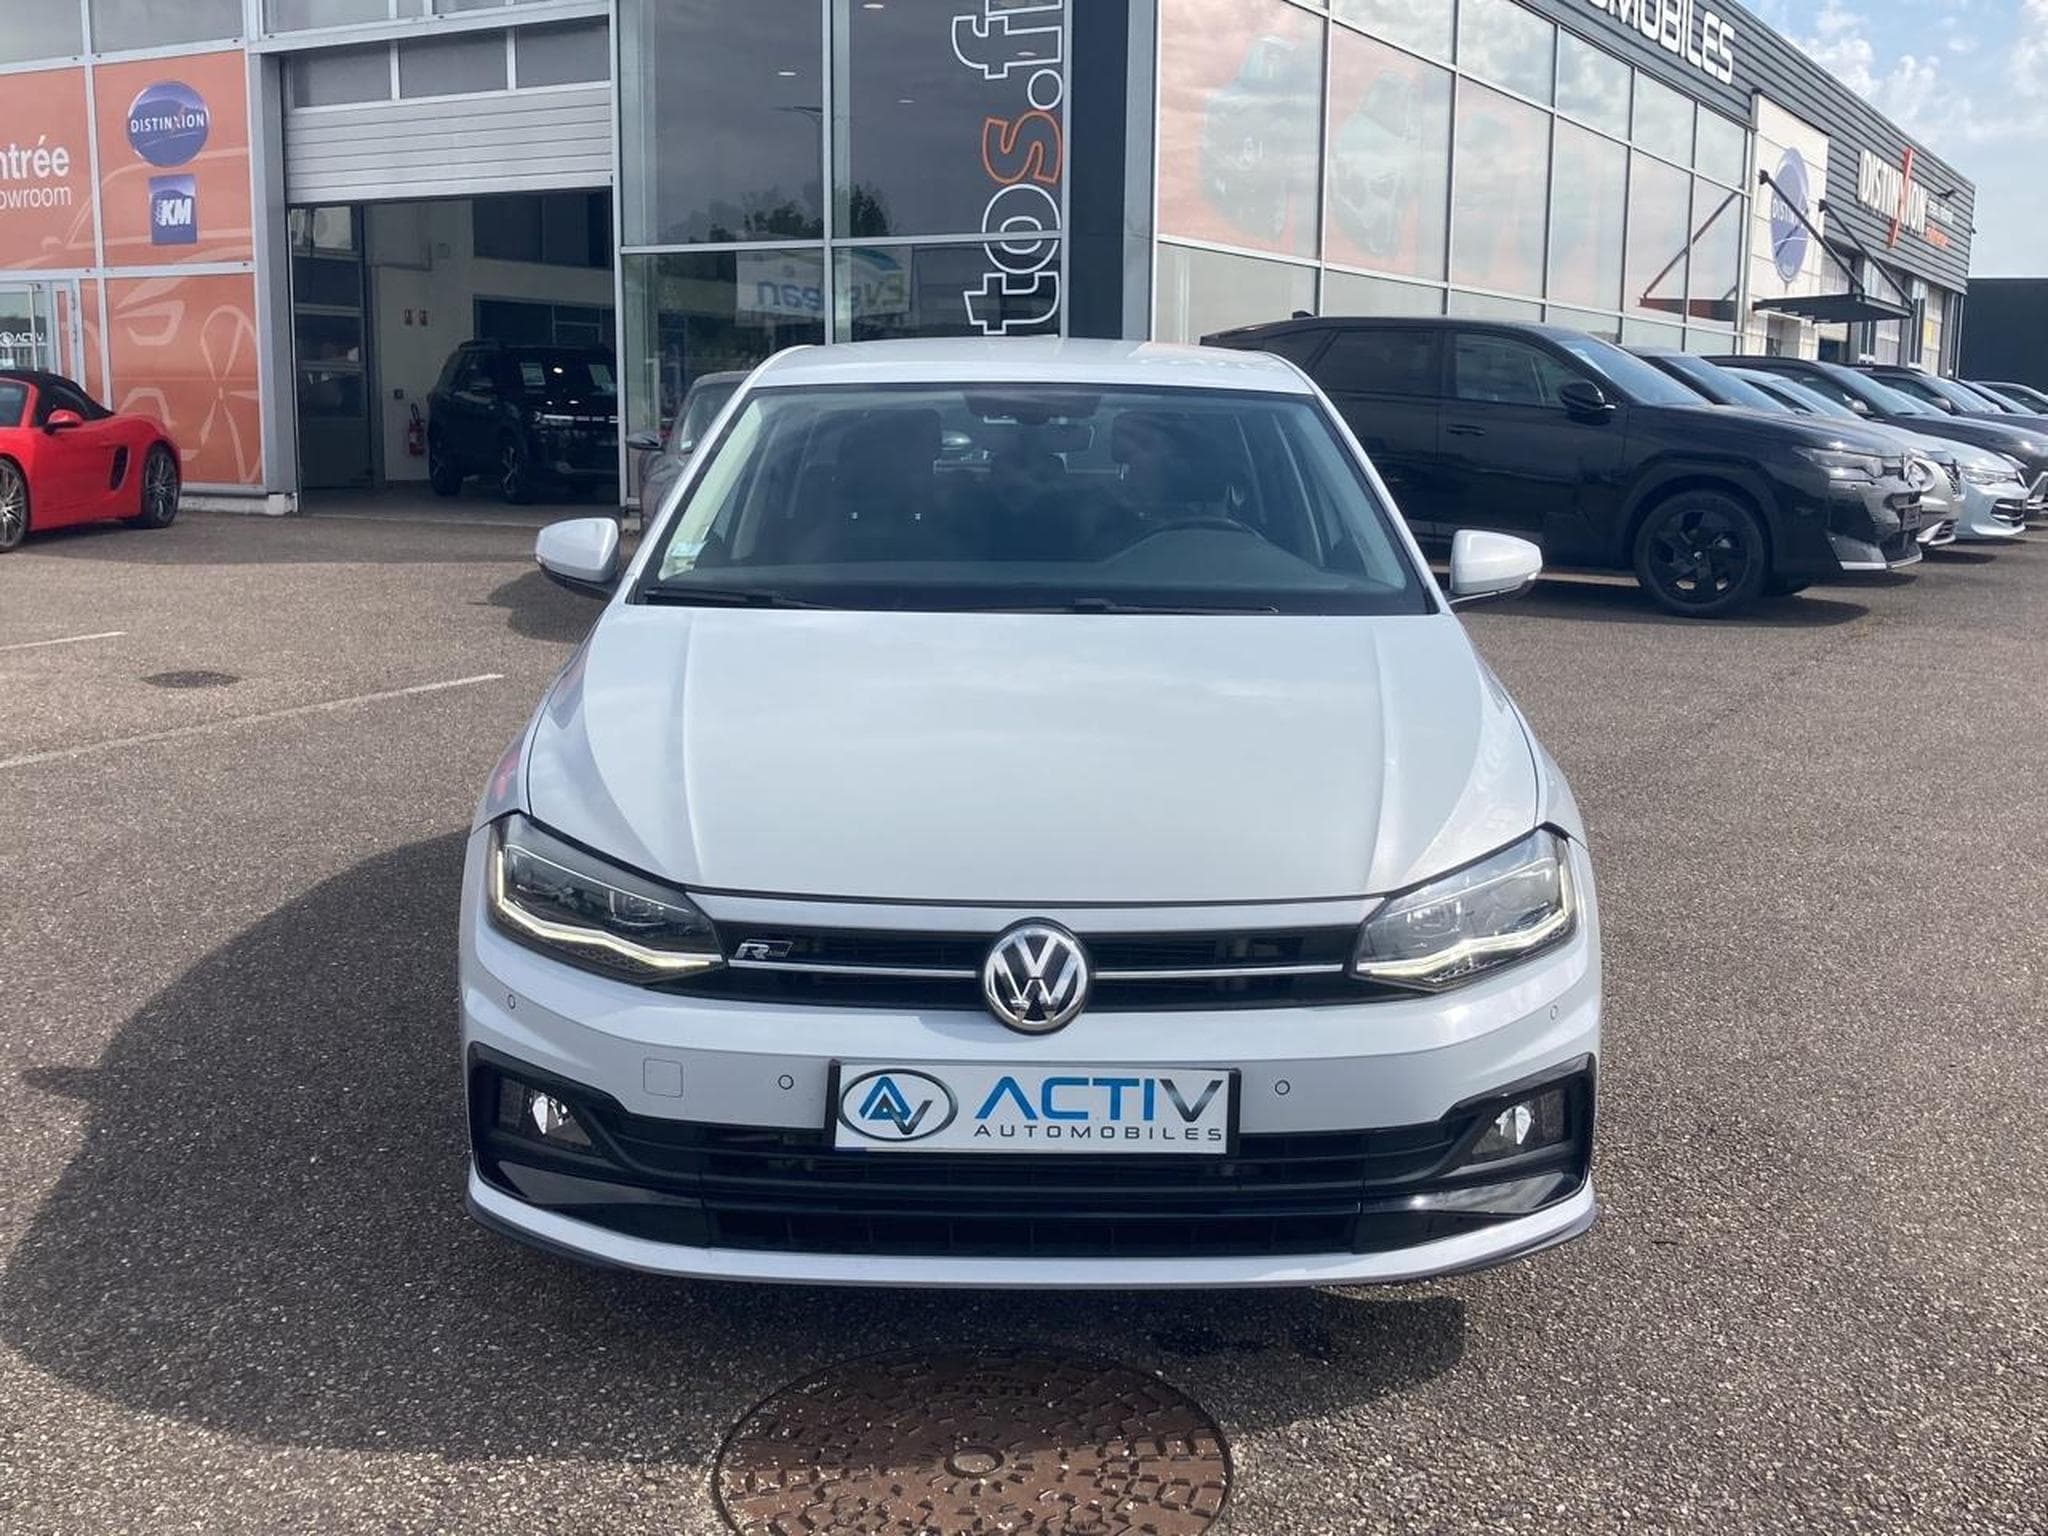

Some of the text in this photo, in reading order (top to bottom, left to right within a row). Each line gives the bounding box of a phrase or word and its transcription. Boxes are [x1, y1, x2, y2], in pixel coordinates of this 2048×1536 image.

[1588, 0, 1735, 85] OBILES
[952, 0, 1064, 335] tos.f
[975, 1076, 1223, 1122] ACTIV
[973, 1124, 1222, 1142] AUTOMOBILES
